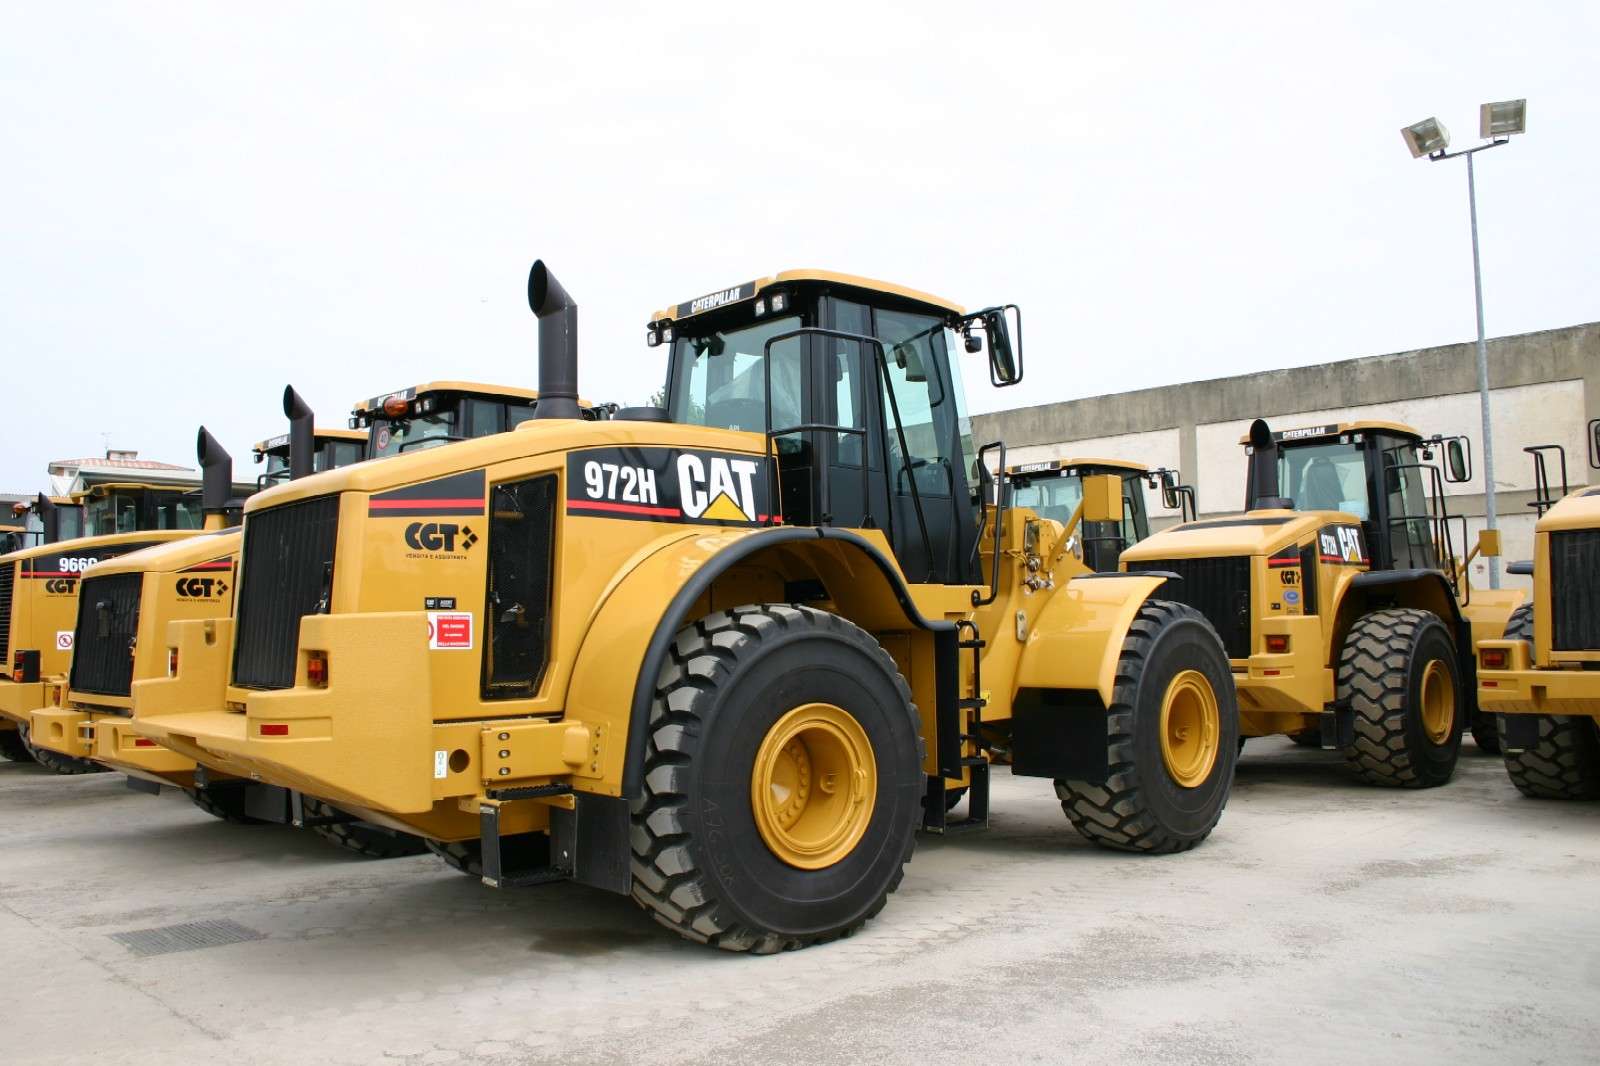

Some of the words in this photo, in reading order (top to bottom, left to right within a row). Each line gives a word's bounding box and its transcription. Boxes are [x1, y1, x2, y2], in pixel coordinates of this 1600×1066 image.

[691, 287, 740, 314] CATERPILLAR
[1282, 427, 1326, 440] CATERPILLAR
[584, 460, 658, 505] 972H
[677, 453, 757, 522] CAT
[405, 522, 459, 552] CGT
[1337, 526, 1363, 562] CAT
[45, 579, 77, 594] CGT
[175, 577, 215, 598] CGT
[1280, 570, 1295, 585] CGT
